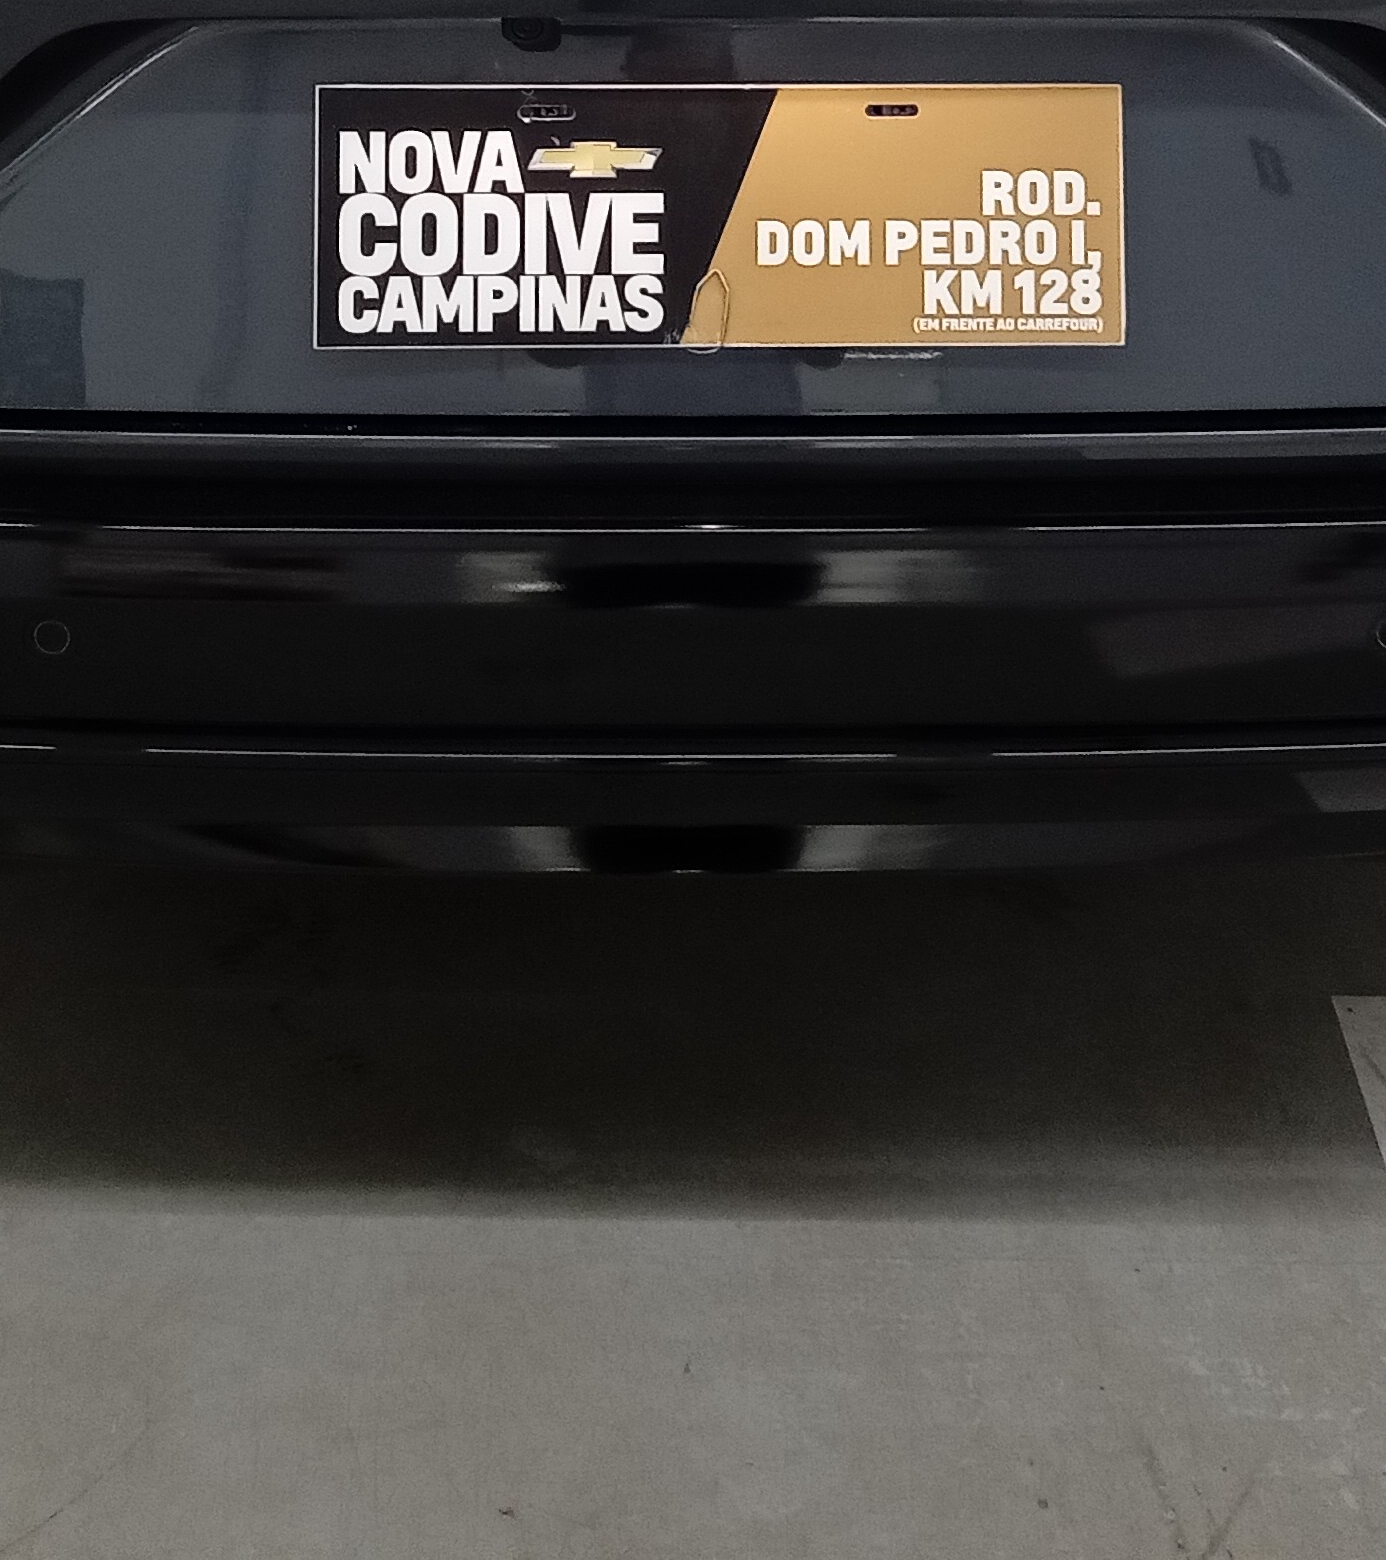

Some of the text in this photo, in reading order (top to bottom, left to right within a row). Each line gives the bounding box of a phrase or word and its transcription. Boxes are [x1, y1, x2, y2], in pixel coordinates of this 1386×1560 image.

[338, 130, 525, 194] NOVA
[981, 169, 1101, 216] ROD.
[338, 192, 664, 276] CODIVE
[756, 219, 1102, 274] DOM PEDRO I,
[338, 274, 664, 334] CAMPINAS
[923, 268, 1102, 315] KM 128
[913, 317, 1104, 334] (EM FRENTE AO CARREFOUR)
